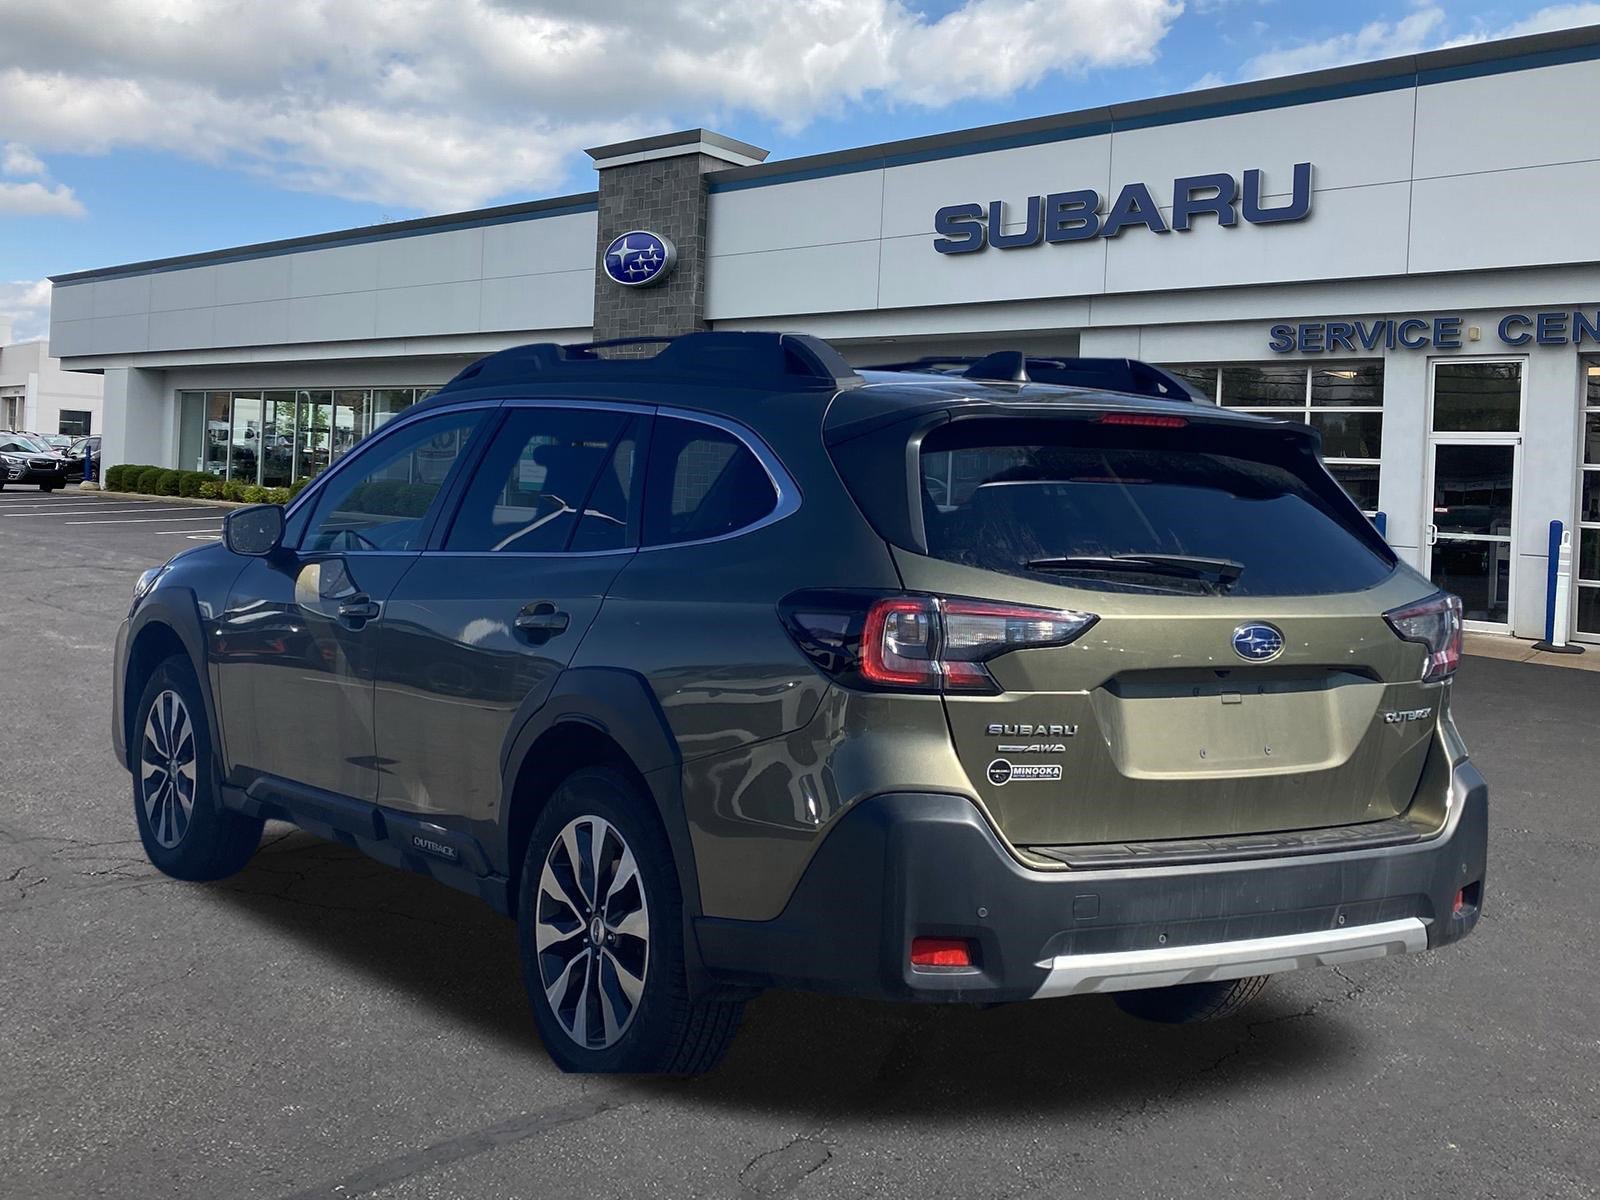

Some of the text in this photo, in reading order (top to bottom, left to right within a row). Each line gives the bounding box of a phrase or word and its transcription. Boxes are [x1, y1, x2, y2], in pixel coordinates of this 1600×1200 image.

[934, 162, 1313, 255] SUBARU
[1269, 317, 1463, 353] SERVICE
[988, 724, 1079, 736] SUBARU
[1025, 744, 1066, 753] AWD
[1013, 767, 1059, 775] MINOOKA
[413, 836, 456, 857] OUTBACK
